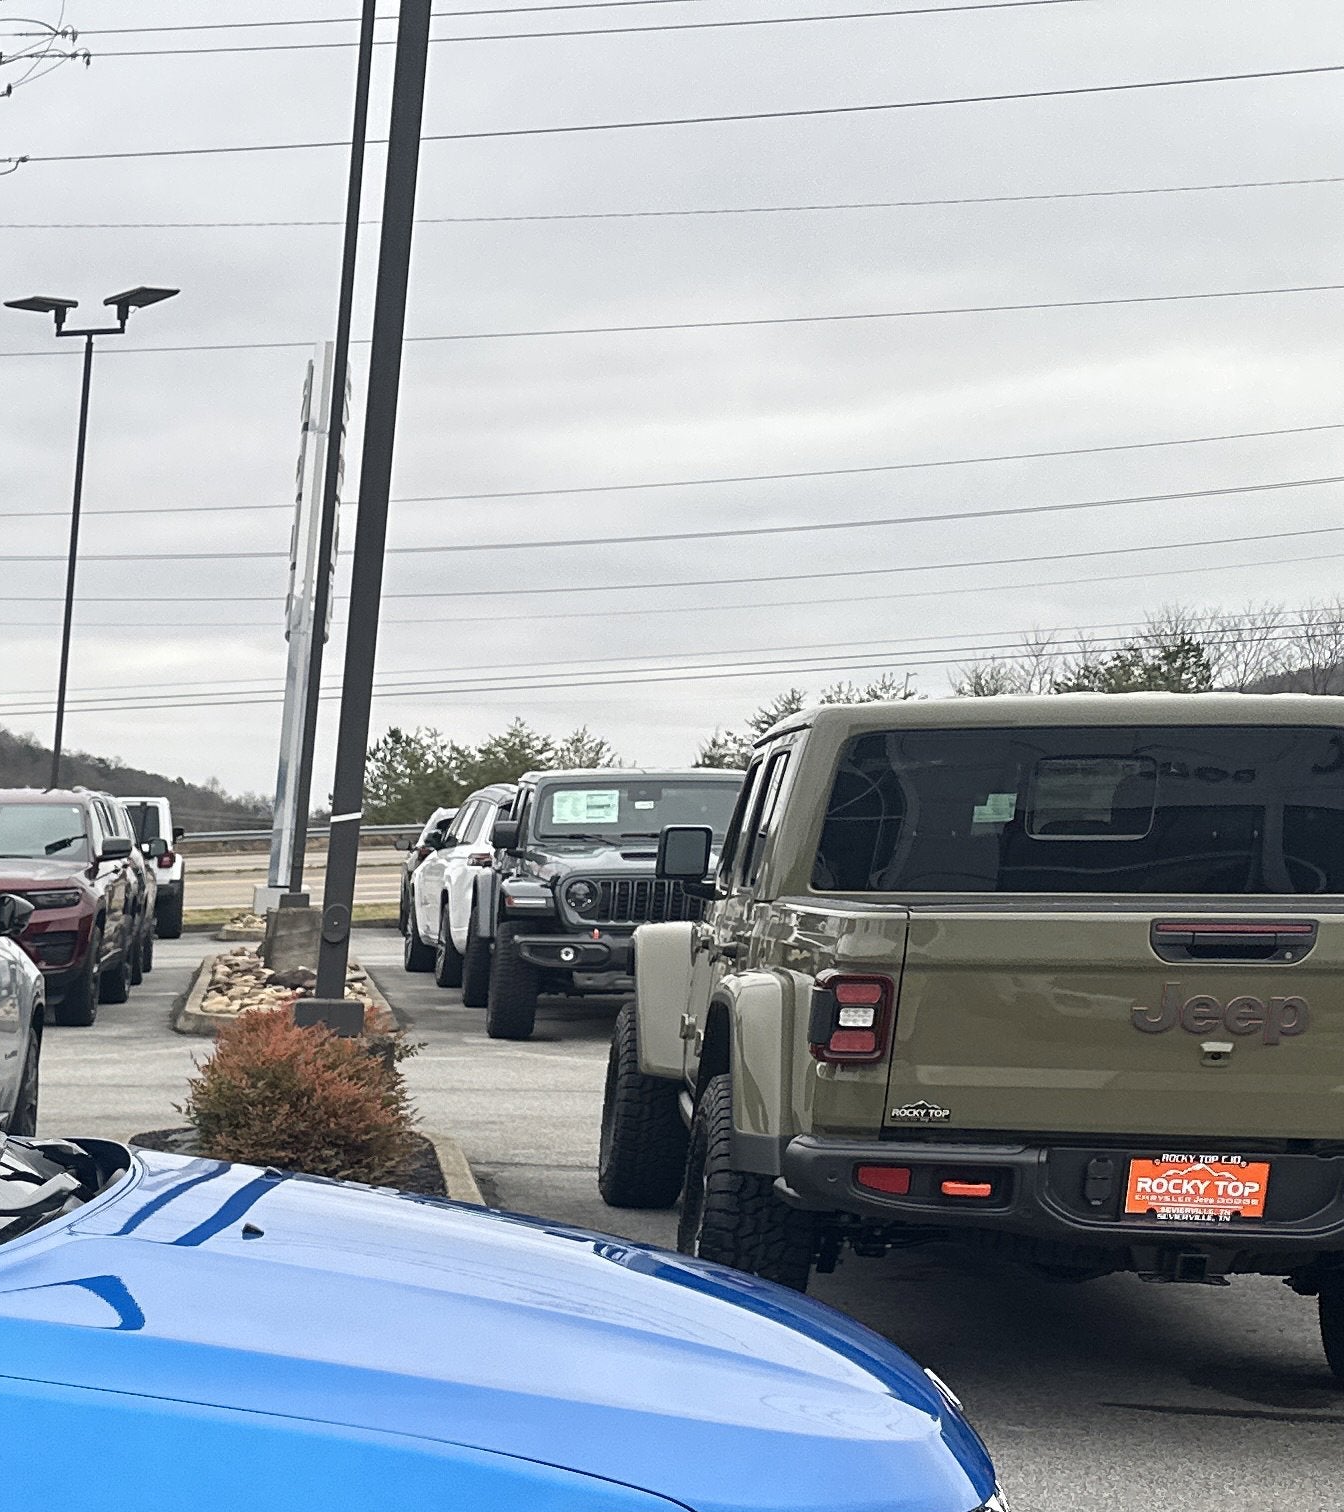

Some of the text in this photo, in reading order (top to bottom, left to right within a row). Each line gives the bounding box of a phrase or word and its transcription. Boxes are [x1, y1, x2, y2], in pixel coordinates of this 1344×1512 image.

[1132, 981, 1310, 1046] Jeep
[891, 1108, 950, 1118] ROCKY TOP
[1161, 1154, 1196, 1163] ROCKY
[1199, 1155, 1219, 1164] TOP
[1136, 1178, 1260, 1197] ROCKY TOP
